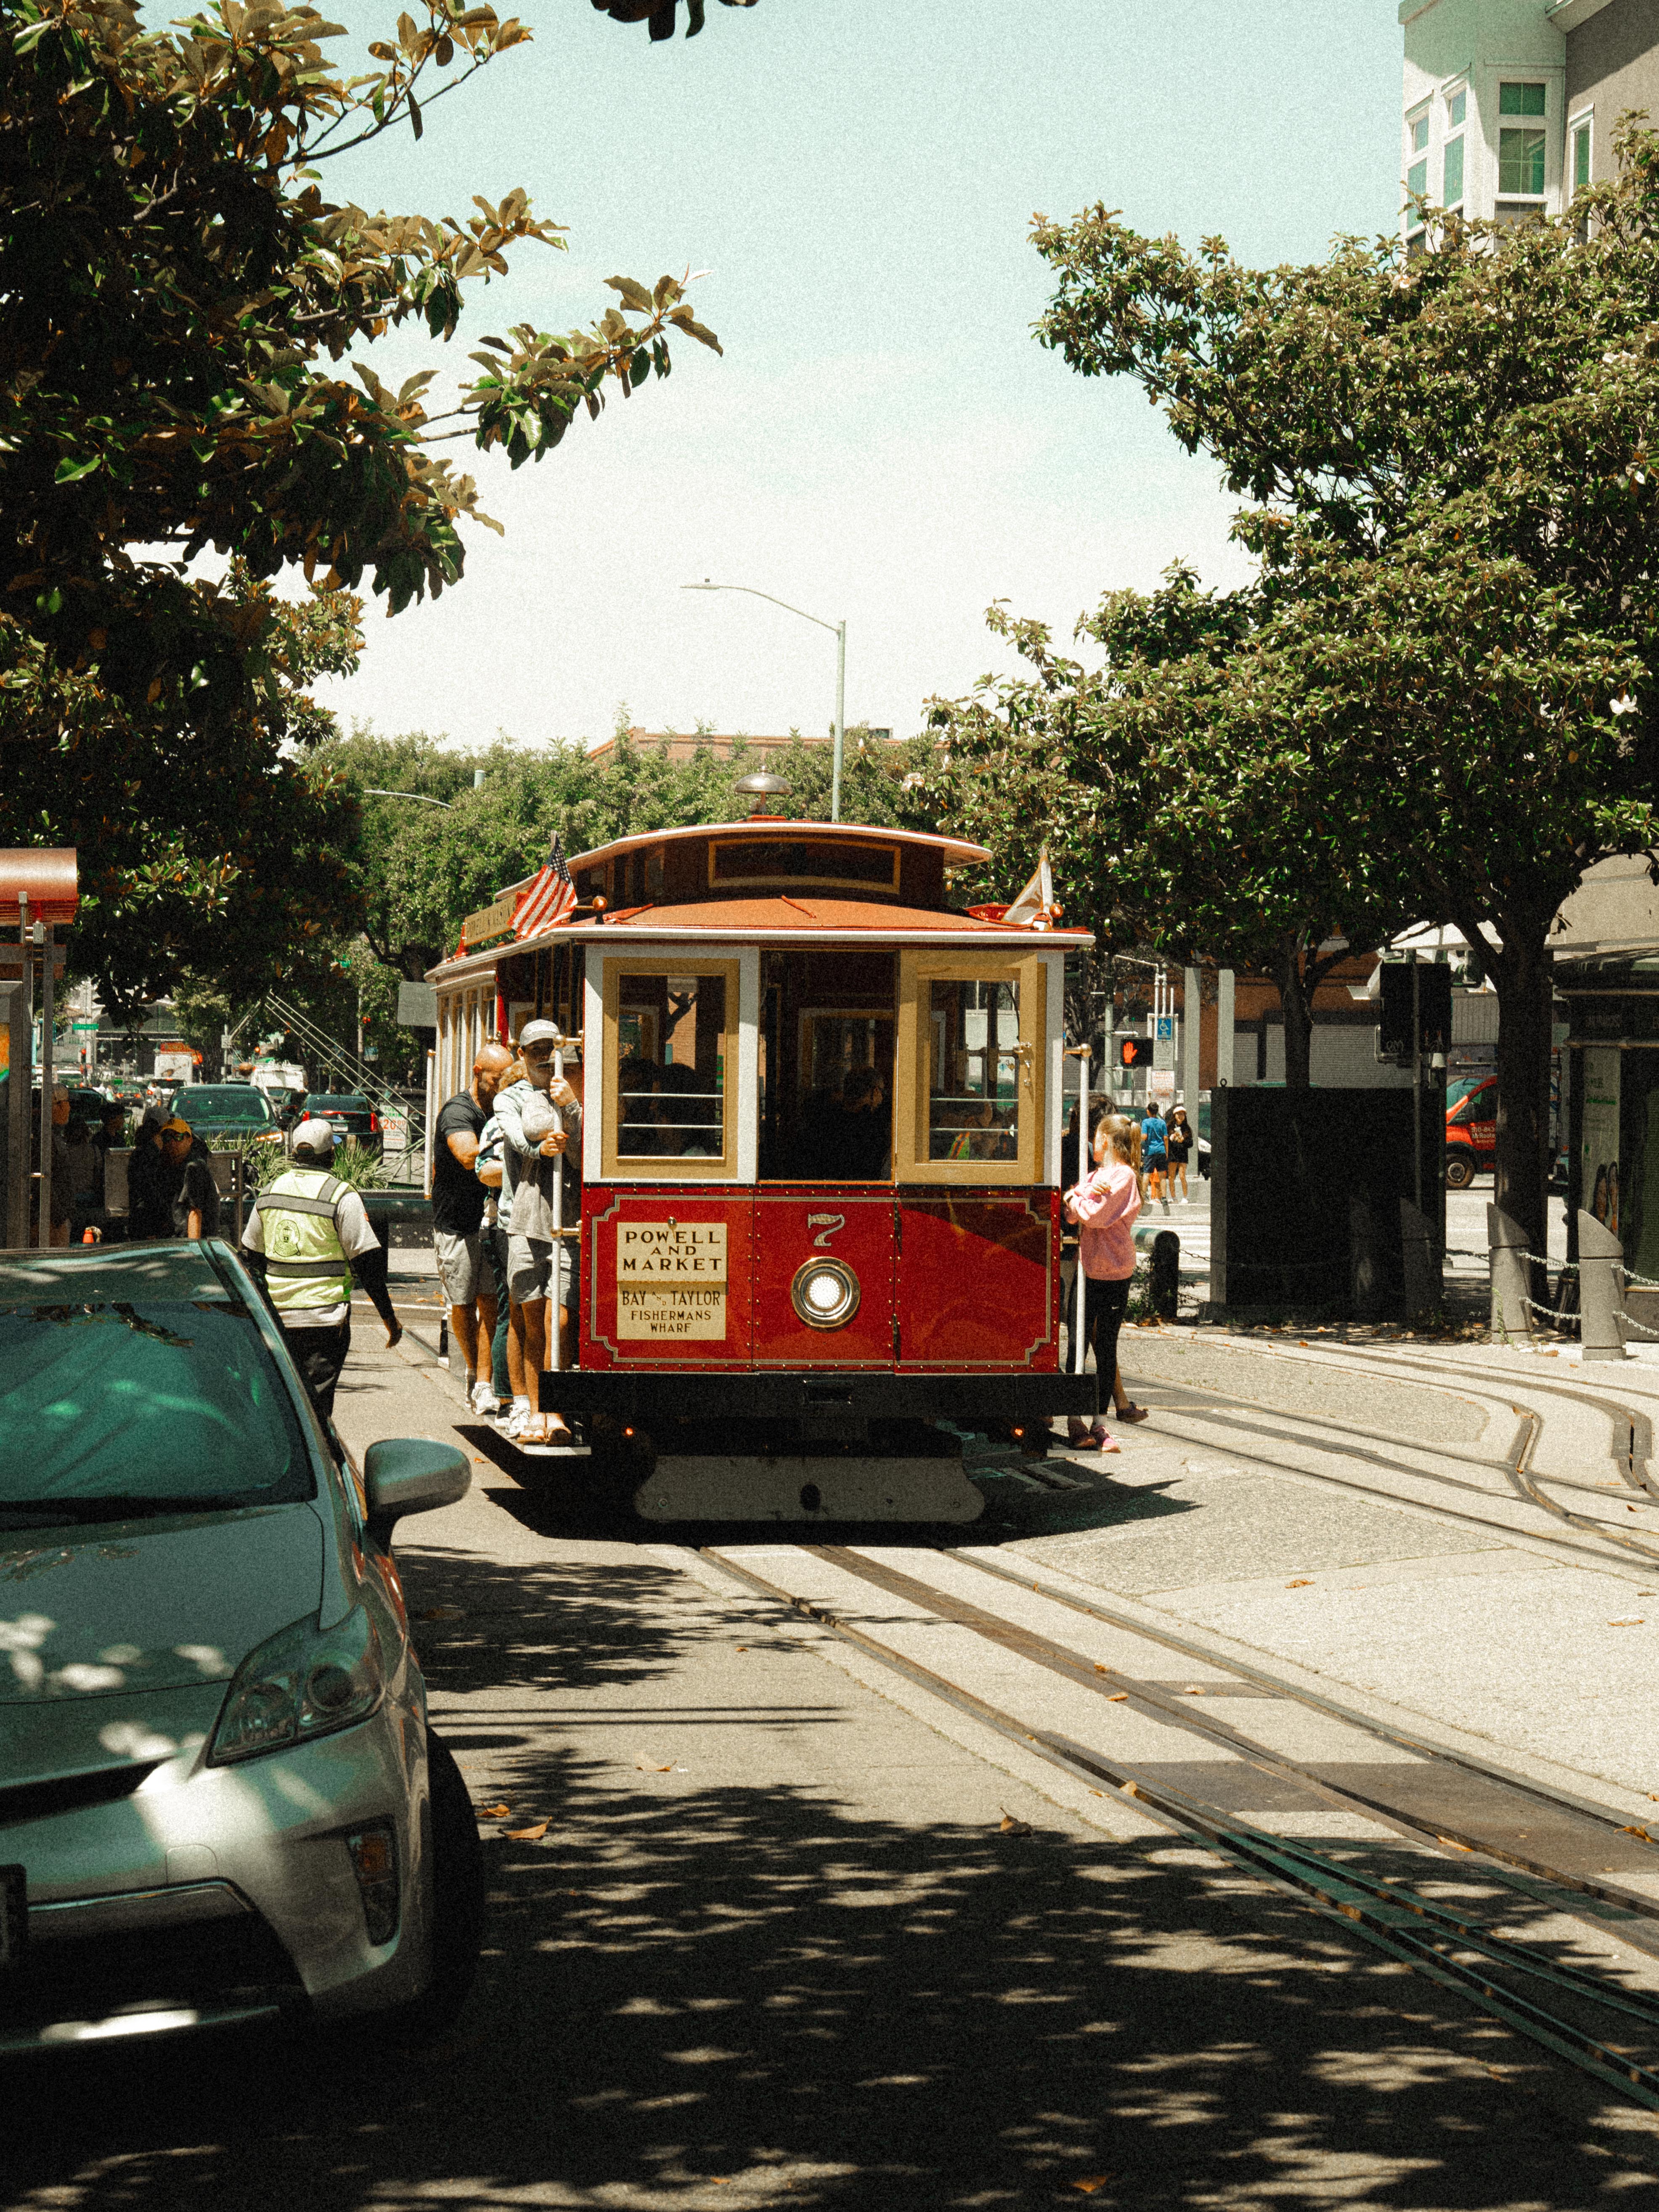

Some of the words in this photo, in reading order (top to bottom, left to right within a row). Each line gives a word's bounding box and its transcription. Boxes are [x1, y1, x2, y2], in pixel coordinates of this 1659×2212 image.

[808, 1213, 845, 1246] 7
[625, 1231, 720, 1243] POWELL
[651, 1246, 696, 1255] AND
[623, 1258, 721, 1270] MARKET
[622, 1291, 646, 1306] BAY
[652, 1291, 666, 1306] AND
[670, 1291, 720, 1306] TAYLOR
[631, 1310, 711, 1320] FISHERMANS
[651, 1323, 692, 1332] WHARF
